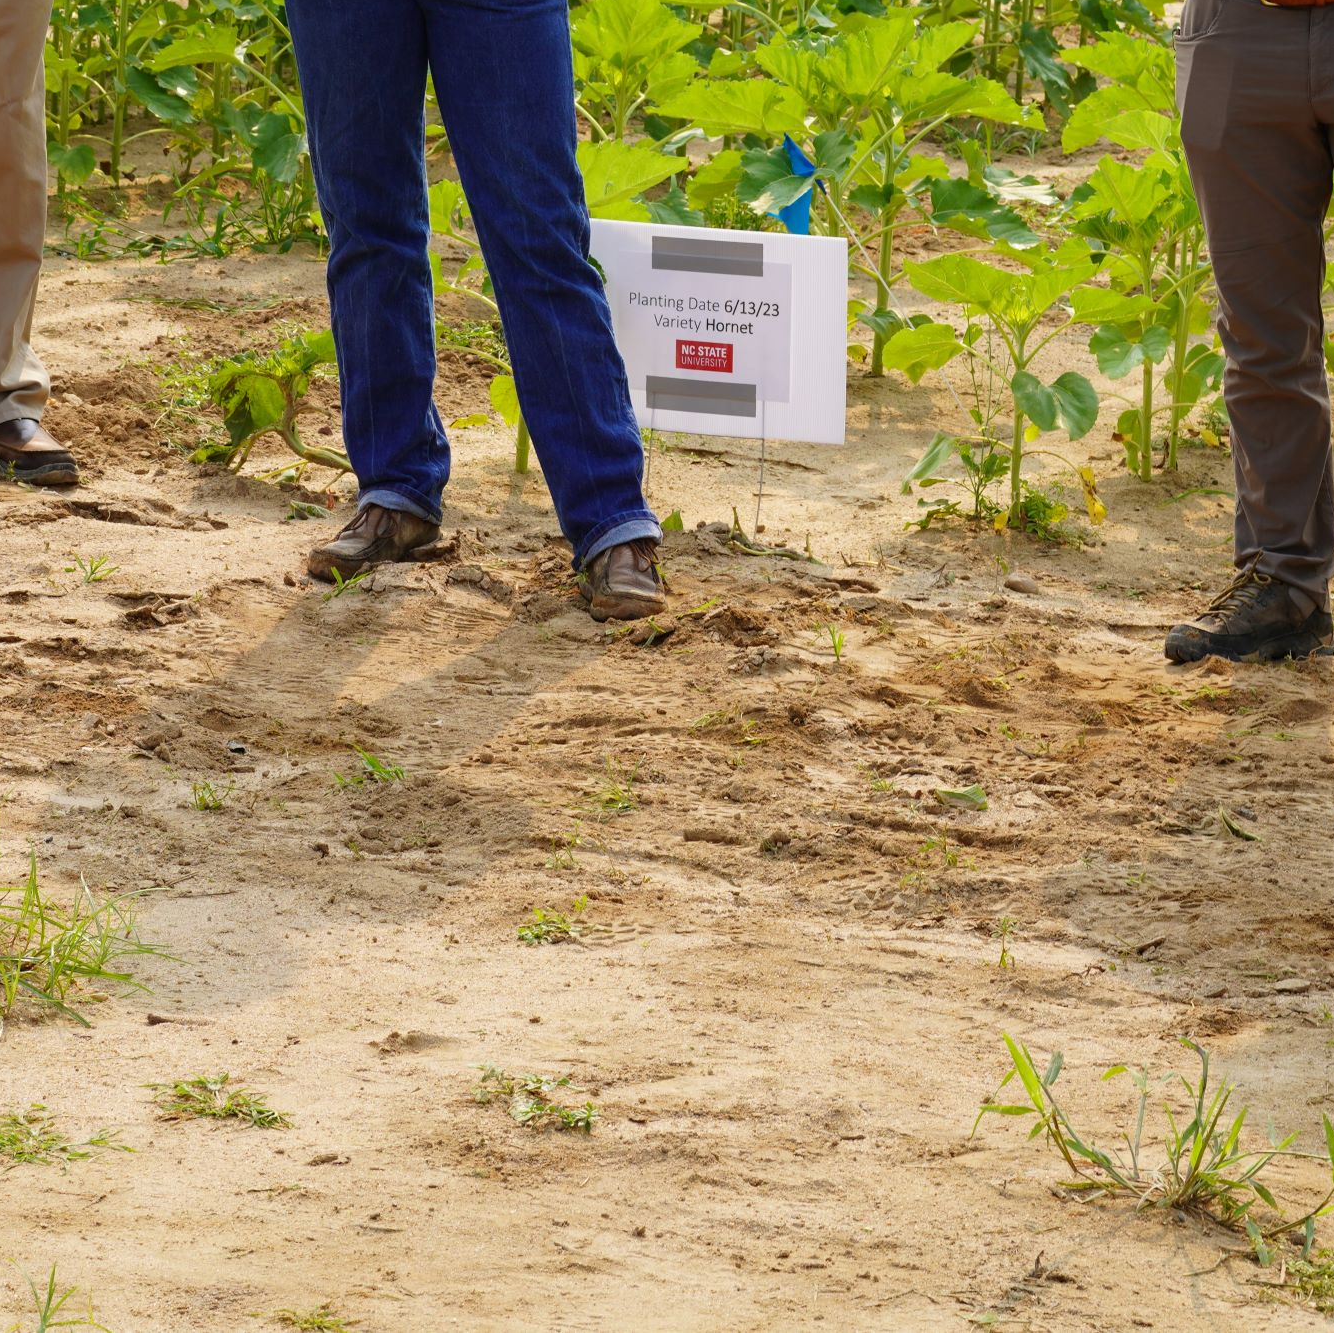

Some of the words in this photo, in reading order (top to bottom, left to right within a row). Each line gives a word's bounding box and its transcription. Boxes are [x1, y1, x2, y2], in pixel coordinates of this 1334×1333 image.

[628, 292, 684, 311] Planting
[688, 297, 720, 312] Date
[724, 299, 780, 317] 6/13/23
[653, 314, 702, 333] Variety
[706, 318, 754, 335] Hornet
[681, 344, 696, 356] NC
[698, 346, 727, 358] STATE
[681, 357, 728, 368] UNIVERSITY
